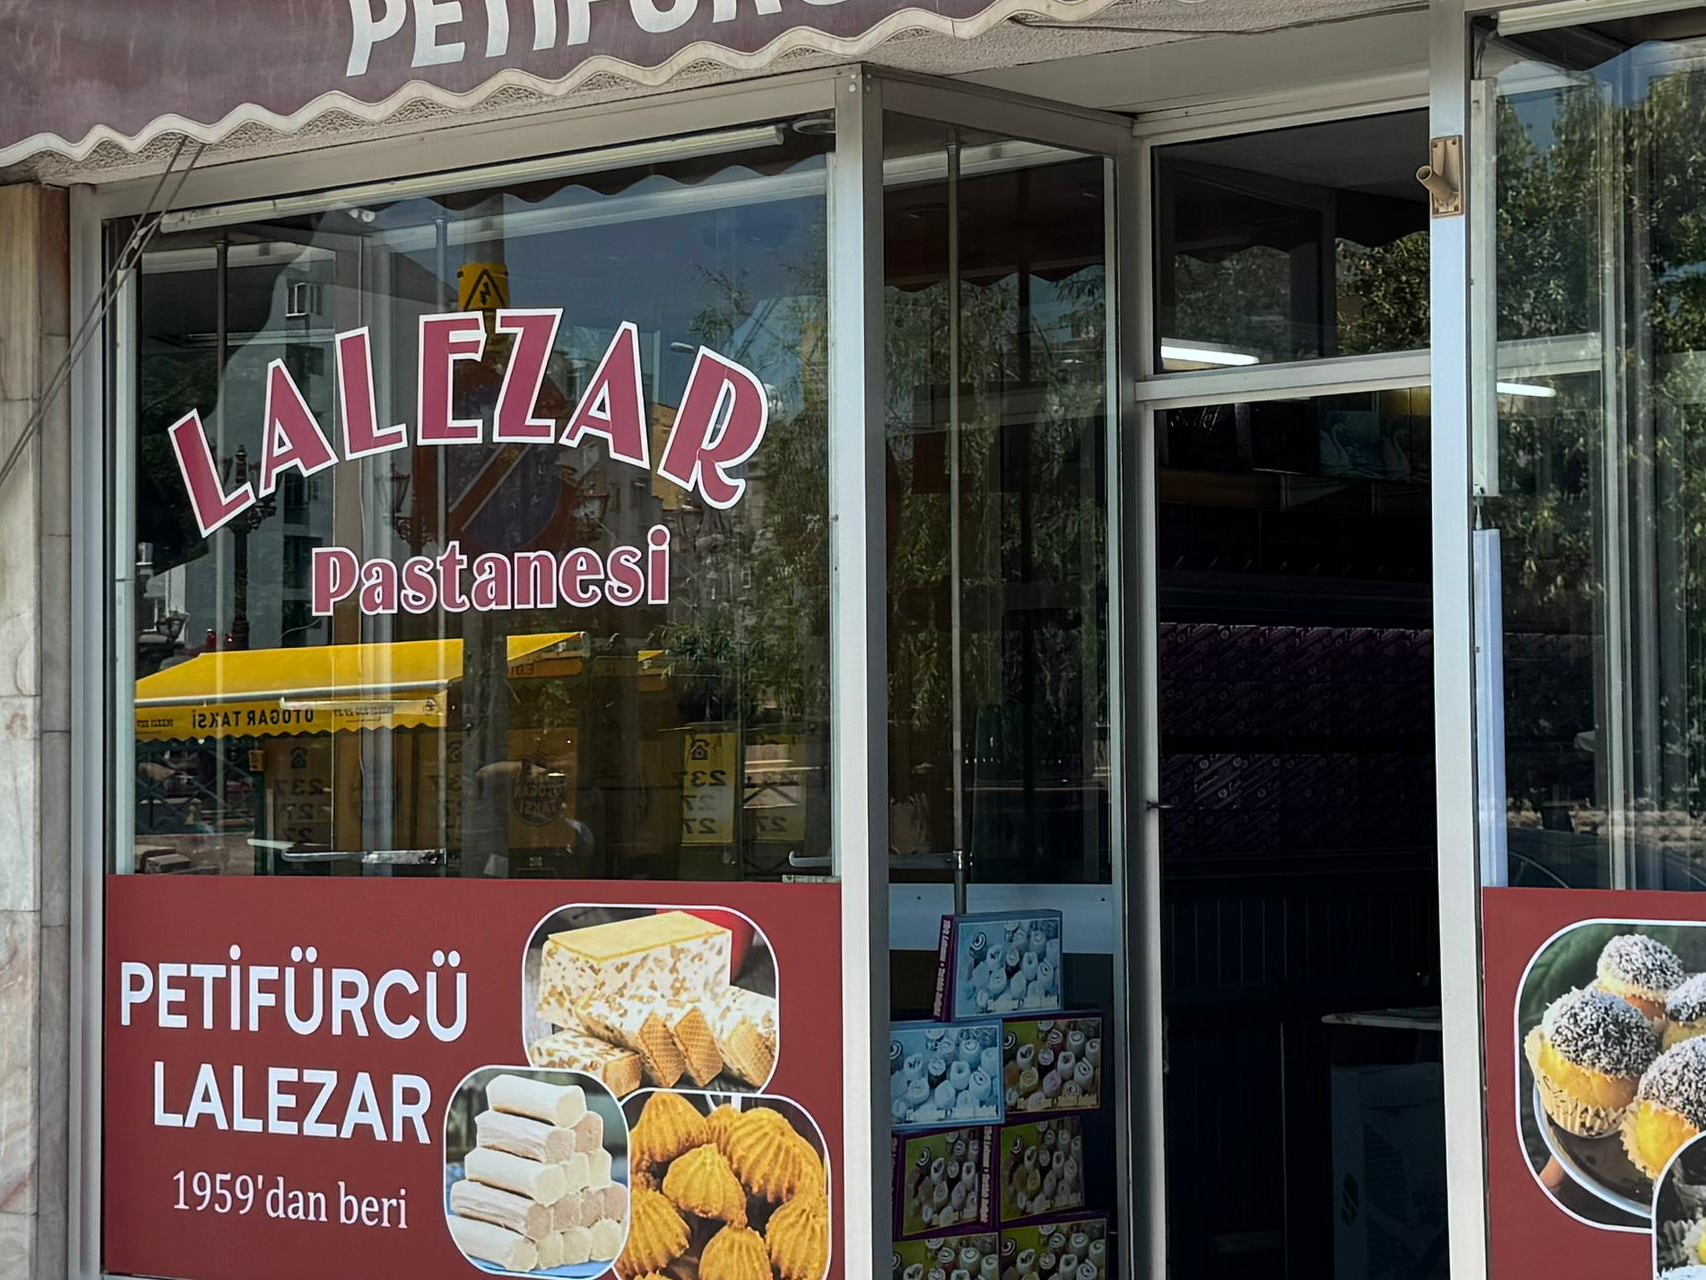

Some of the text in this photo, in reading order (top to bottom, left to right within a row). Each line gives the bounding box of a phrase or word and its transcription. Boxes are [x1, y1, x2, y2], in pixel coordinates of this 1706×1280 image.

[167, 307, 769, 538] LALEZAR
[311, 524, 671, 617] Pastanesi
[119, 944, 468, 1042] PETİFÜRCÜ
[153, 1061, 432, 1145] LALEZAR
[172, 1171, 408, 1230] 1959'dan beri
